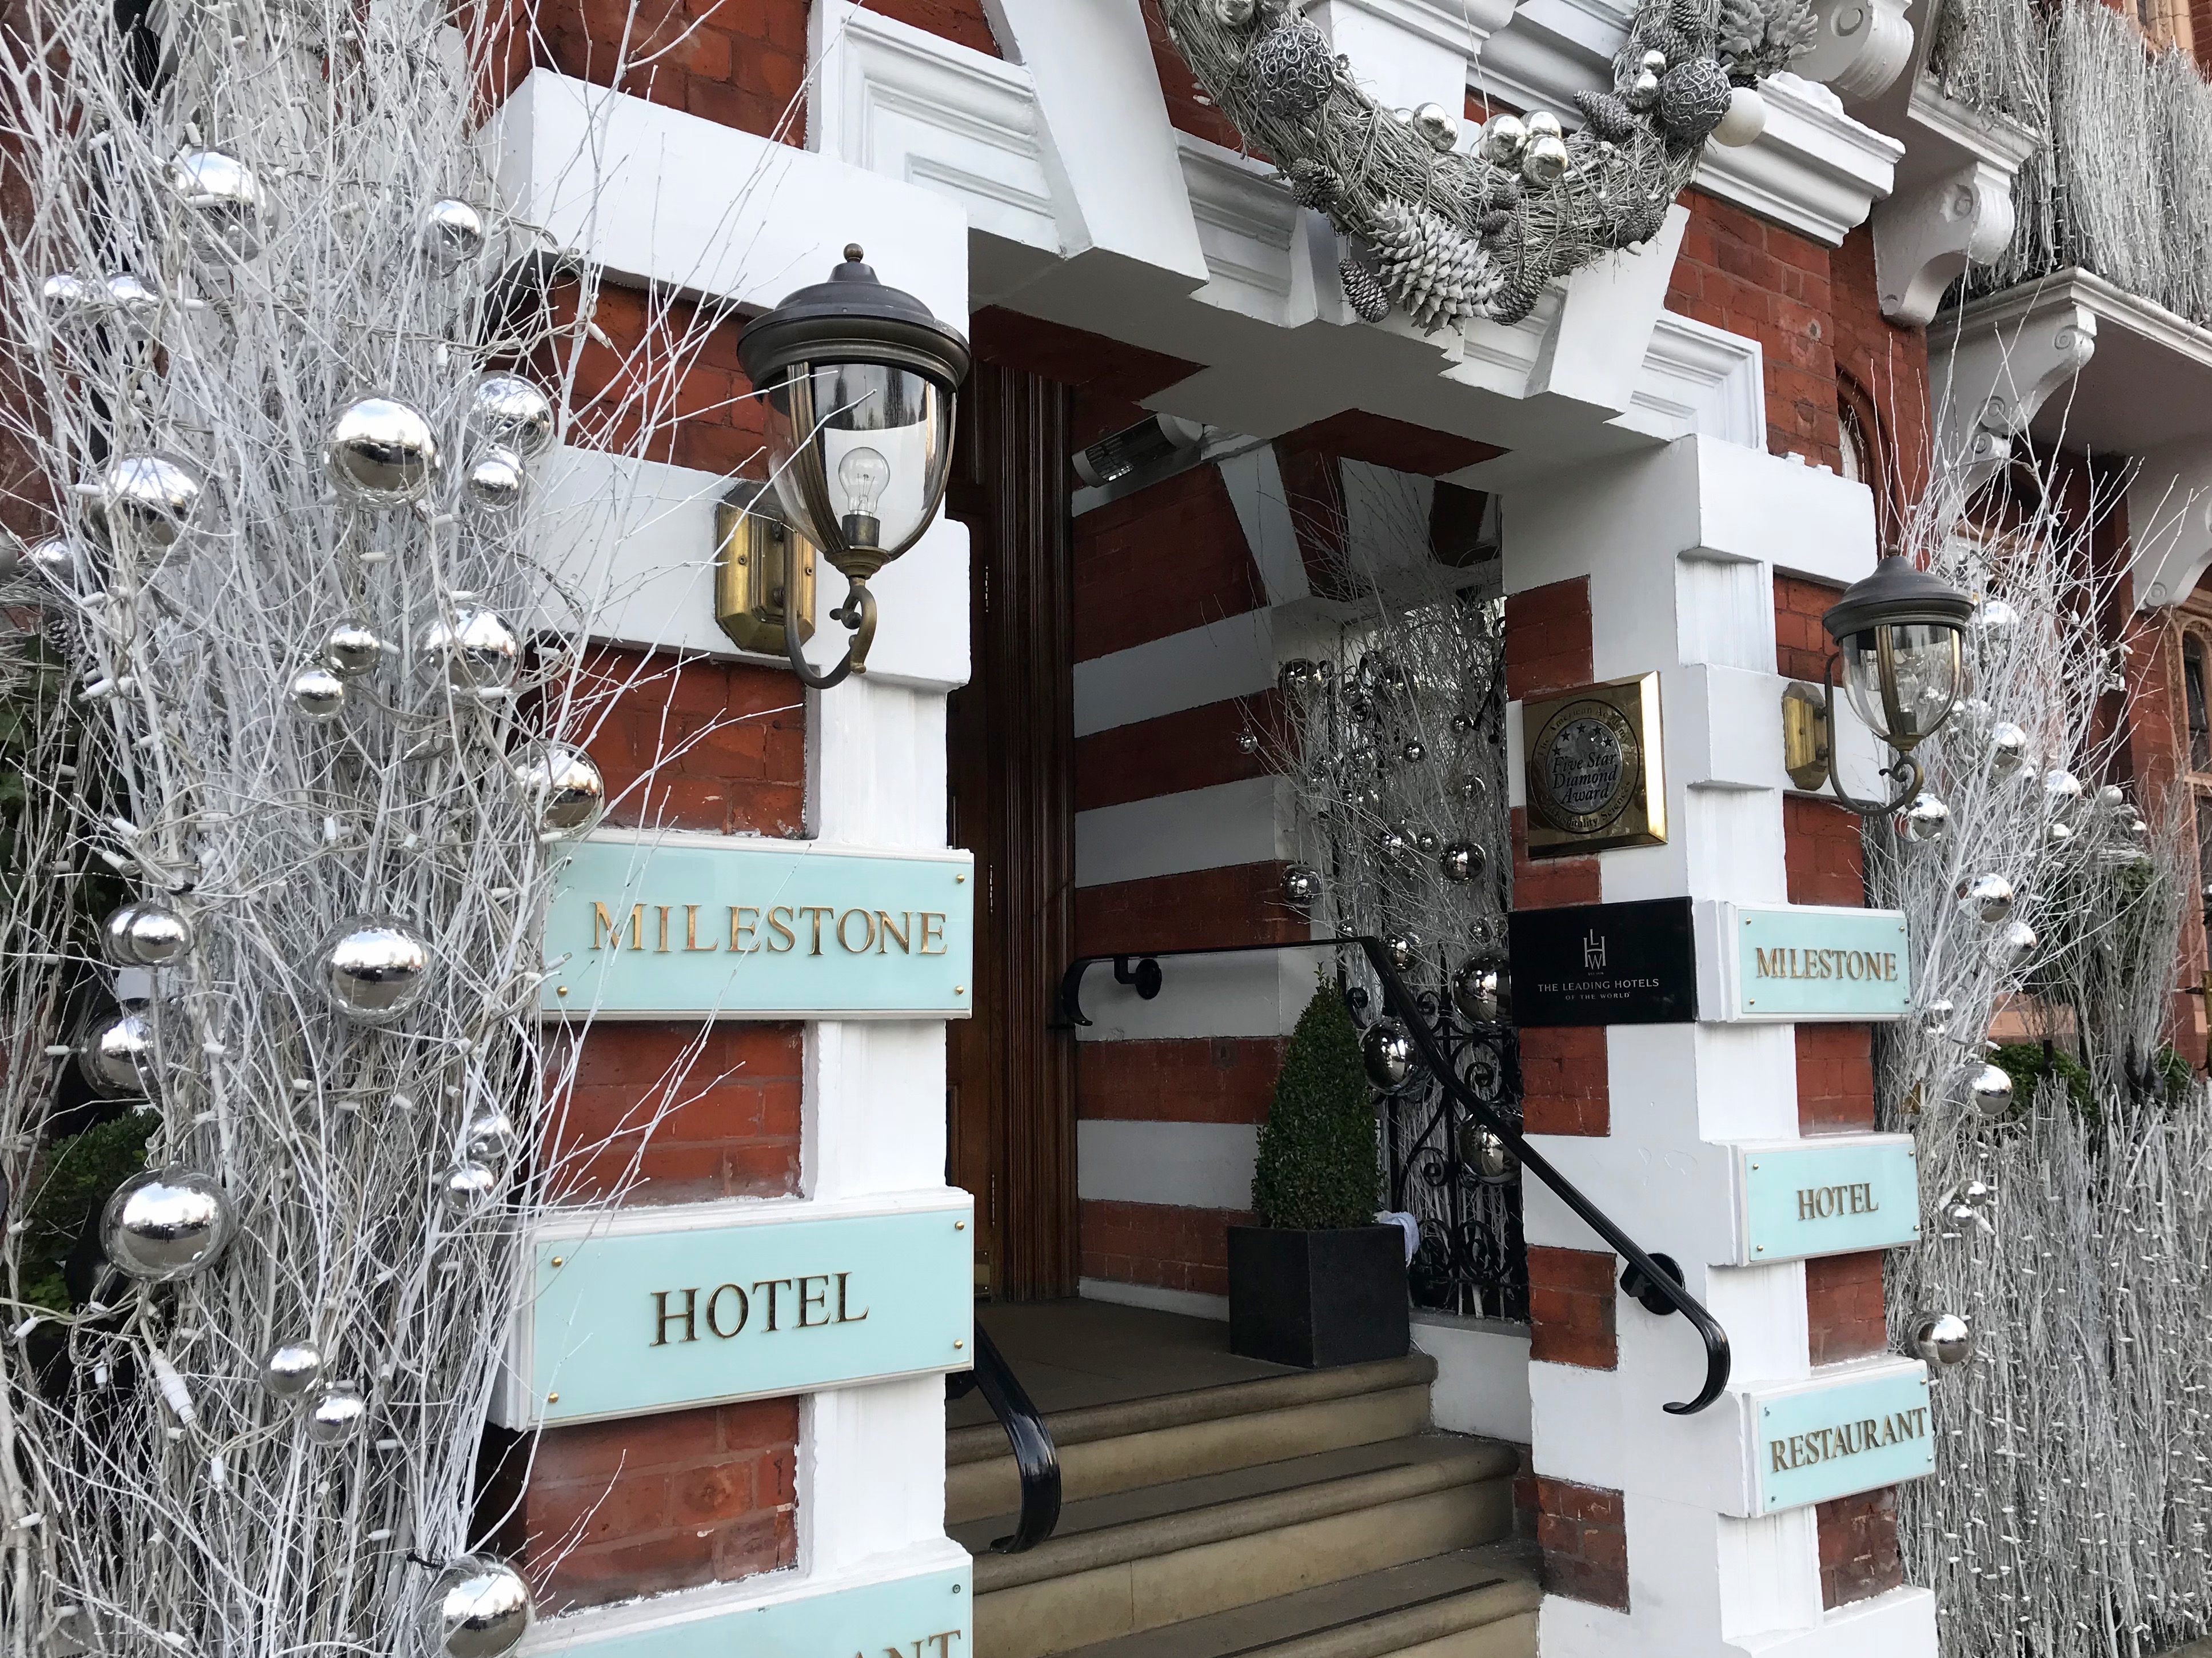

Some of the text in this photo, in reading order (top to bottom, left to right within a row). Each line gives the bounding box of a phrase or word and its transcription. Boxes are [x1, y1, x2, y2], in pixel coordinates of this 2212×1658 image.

[1552, 751, 1617, 773] Five Star
[1552, 765, 1618, 789] Diamond
[1560, 786, 1610, 804] Award
[589, 901, 948, 956] MILESTONE
[1756, 946, 1898, 982] MILESTONE
[1538, 978, 1659, 992] THE LEADING HOTELS
[1798, 1182, 1878, 1221] HOTEL
[649, 1271, 870, 1346] HOTEL
[1770, 1406, 1927, 1473] RESTAURANT
